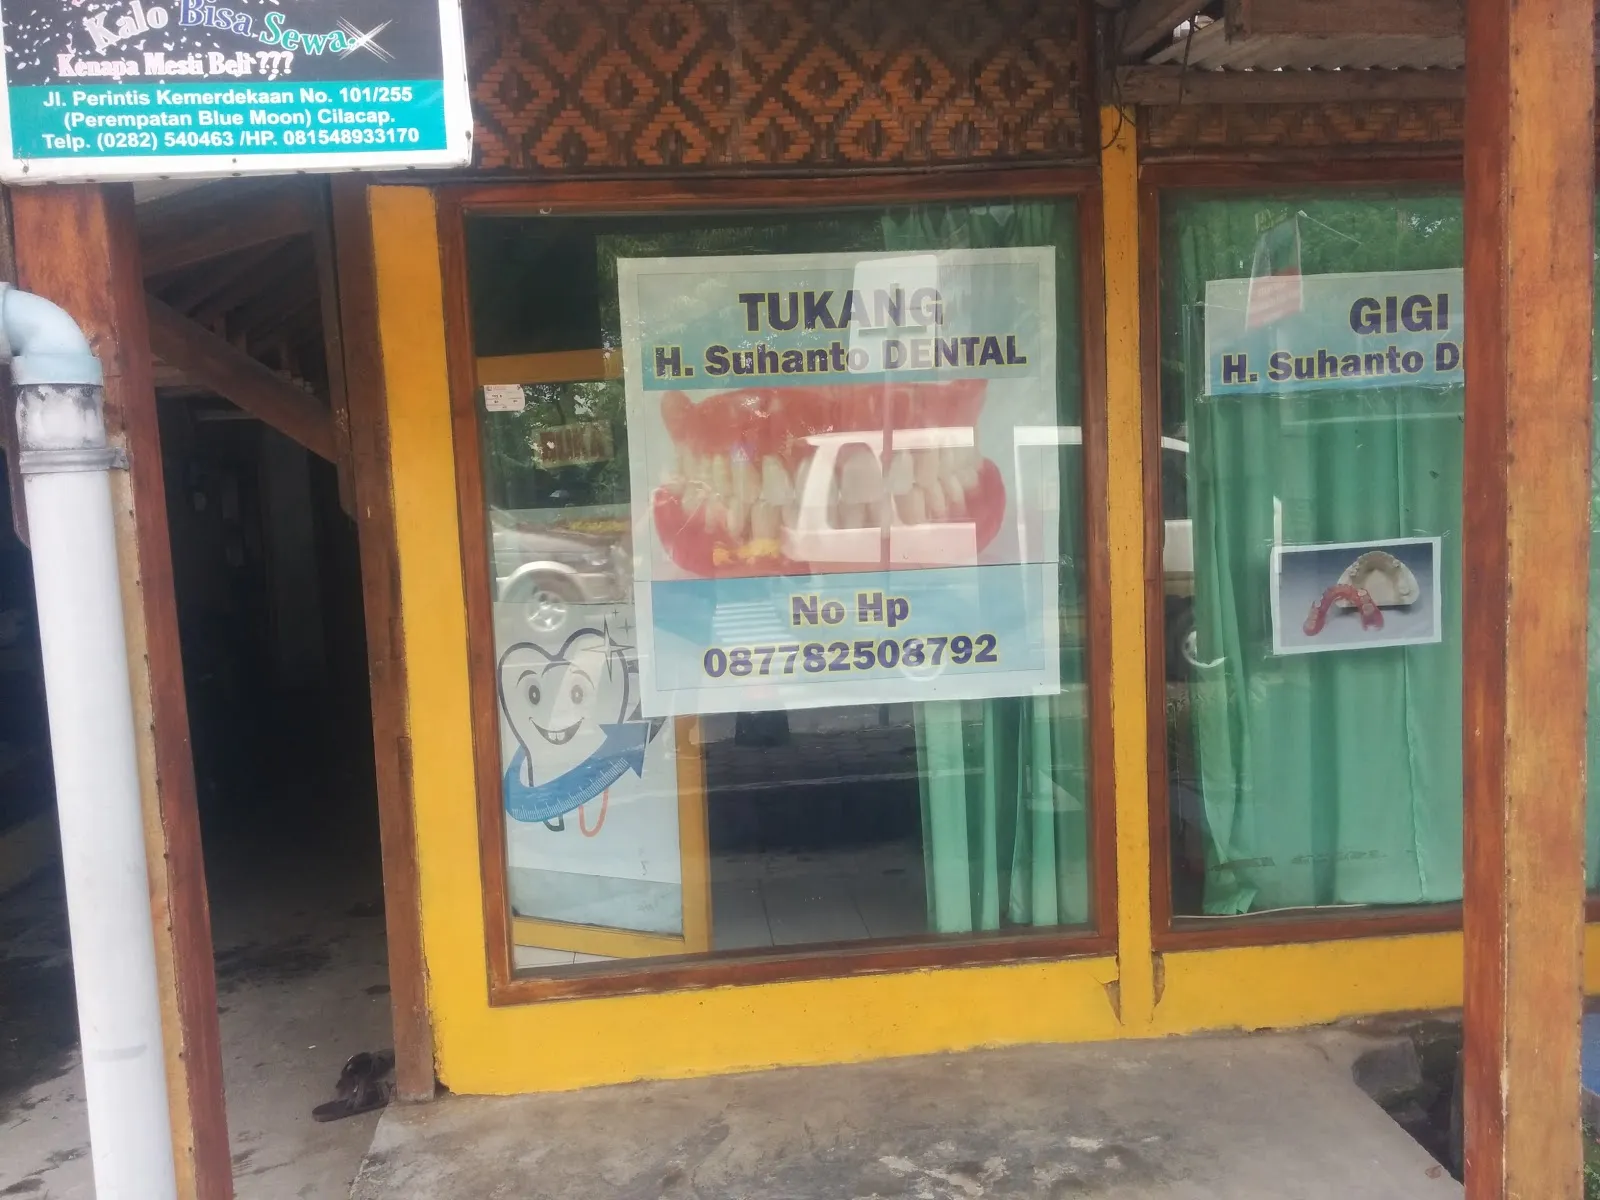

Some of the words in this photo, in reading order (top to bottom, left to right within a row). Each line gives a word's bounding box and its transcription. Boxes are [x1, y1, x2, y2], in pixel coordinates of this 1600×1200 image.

[85, 0, 169, 53] Kalo
[179, 0, 252, 36] Bisa
[57, 53, 140, 80] Kenapa
[143, 52, 204, 77] Mesti
[43, 91, 67, 107] Jl.
[72, 90, 151, 106] Perintis
[156, 88, 294, 105] Kemerdekaan
[299, 87, 333, 104] No.
[339, 86, 413, 103] 101/255
[42, 133, 91, 152] Telp.
[97, 131, 158, 152] (0282)
[164, 131, 234, 148] 540463
[240, 130, 278, 147] /HP.
[283, 127, 420, 146] 081548933170
[64, 111, 193, 131] (Perempatan
[198, 109, 244, 126] Blue
[249, 108, 312, 128] Moon)
[317, 108, 396, 126] Cilacap.
[739, 287, 944, 332] TUKANG
[1350, 292, 1450, 336] GIGI
[655, 346, 696, 378] H.
[704, 338, 870, 376] Suhanto
[880, 334, 1027, 370] DENTAL
[1221, 354, 1260, 385] H.
[1267, 345, 1426, 383] Suhanto
[791, 594, 846, 627] No
[857, 591, 910, 628] Hp
[702, 632, 999, 680] 087782508792
